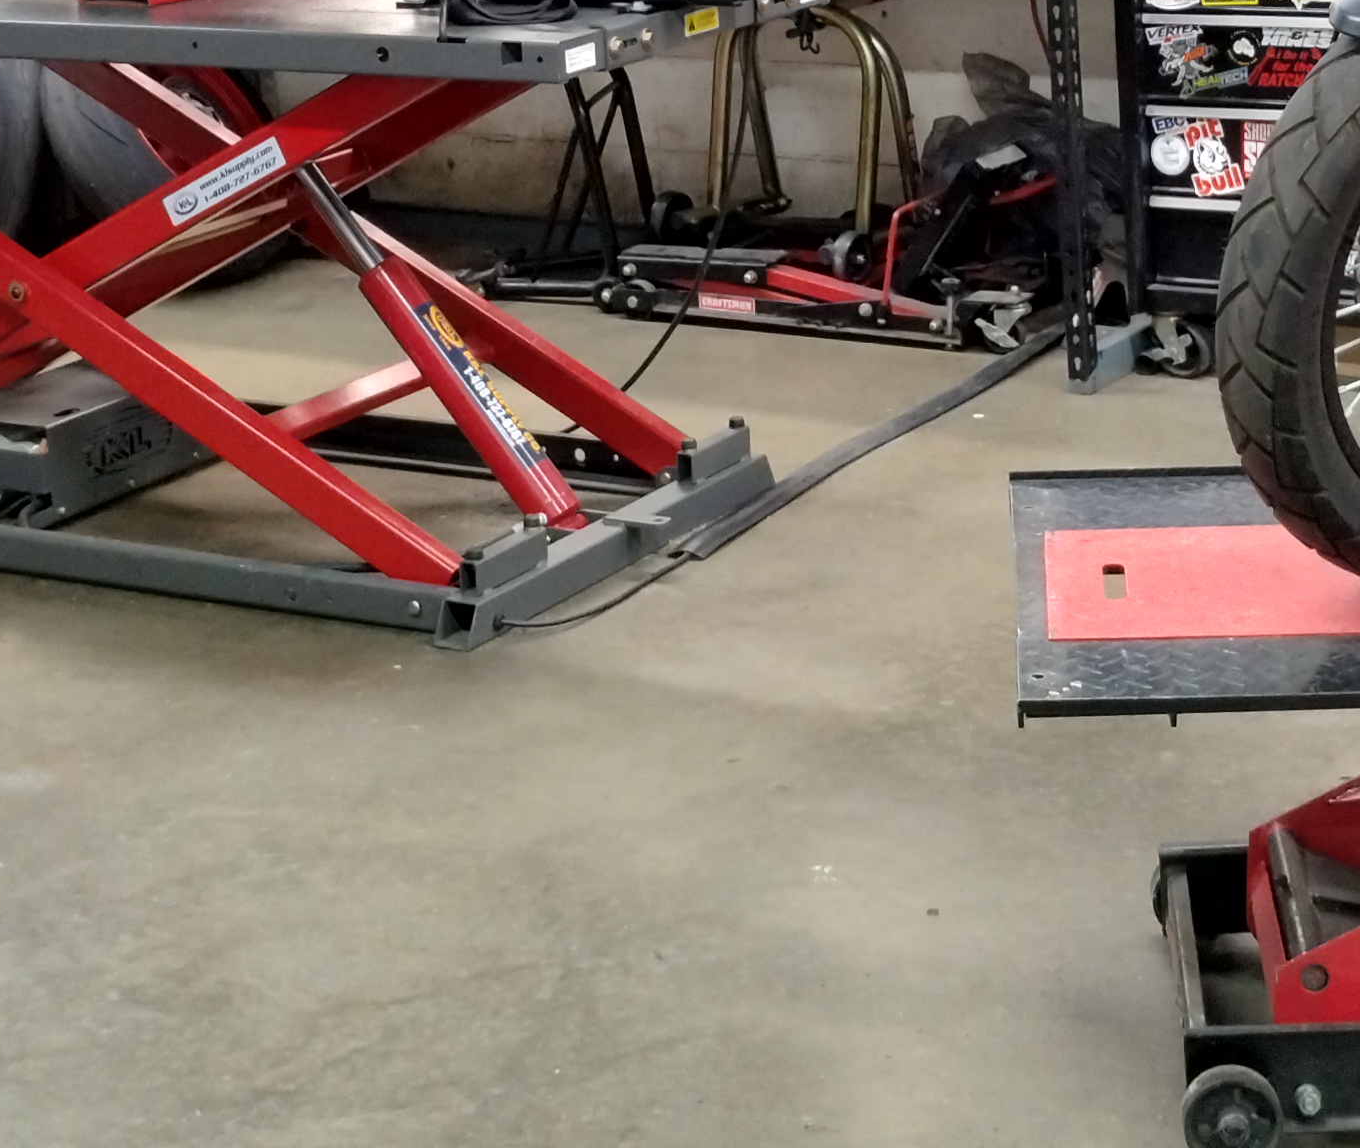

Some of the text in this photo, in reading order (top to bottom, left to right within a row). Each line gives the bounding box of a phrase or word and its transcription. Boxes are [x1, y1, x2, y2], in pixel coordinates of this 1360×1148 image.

[1147, 25, 1201, 39] VERTEX
[1185, 118, 1222, 146] pit
[204, 156, 277, 203] 1-408-727-6767
[1195, 166, 1242, 195] bull
[701, 296, 752, 310] CRAFTSMAN
